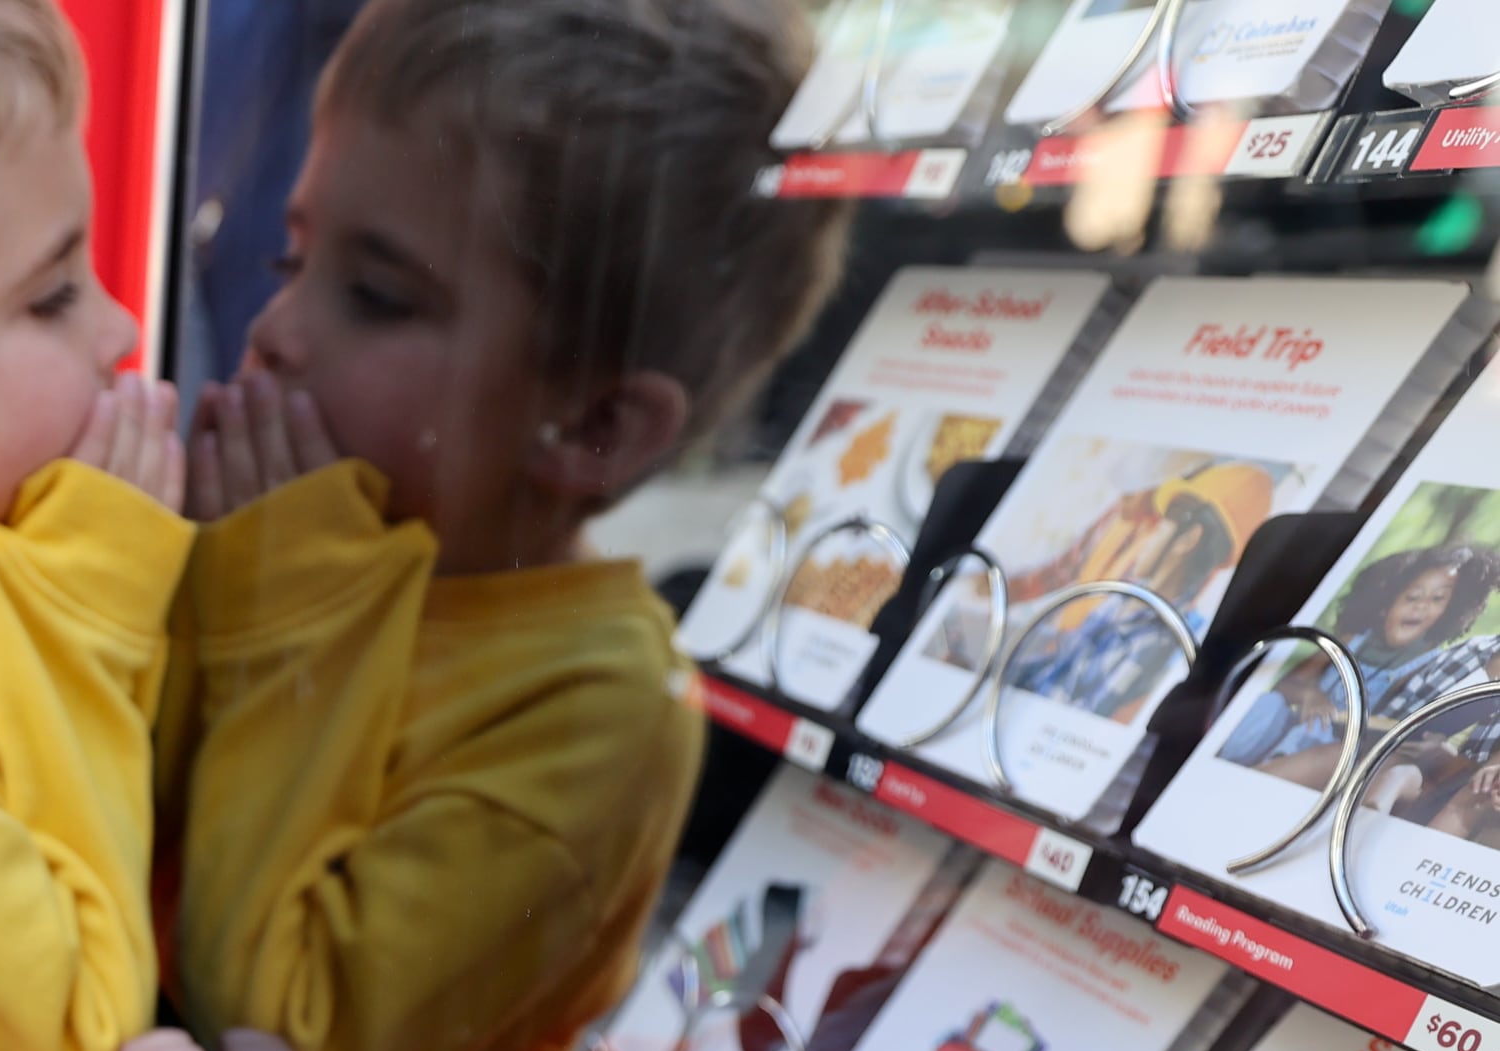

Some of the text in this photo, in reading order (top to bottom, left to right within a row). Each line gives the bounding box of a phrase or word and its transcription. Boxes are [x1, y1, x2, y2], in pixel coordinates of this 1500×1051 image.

[1247, 130, 1293, 160] $25
[1351, 127, 1496, 171] 144 Utility
[1183, 322, 1325, 372] Field Trip
[1118, 873, 1294, 971] 154 Reading Program
